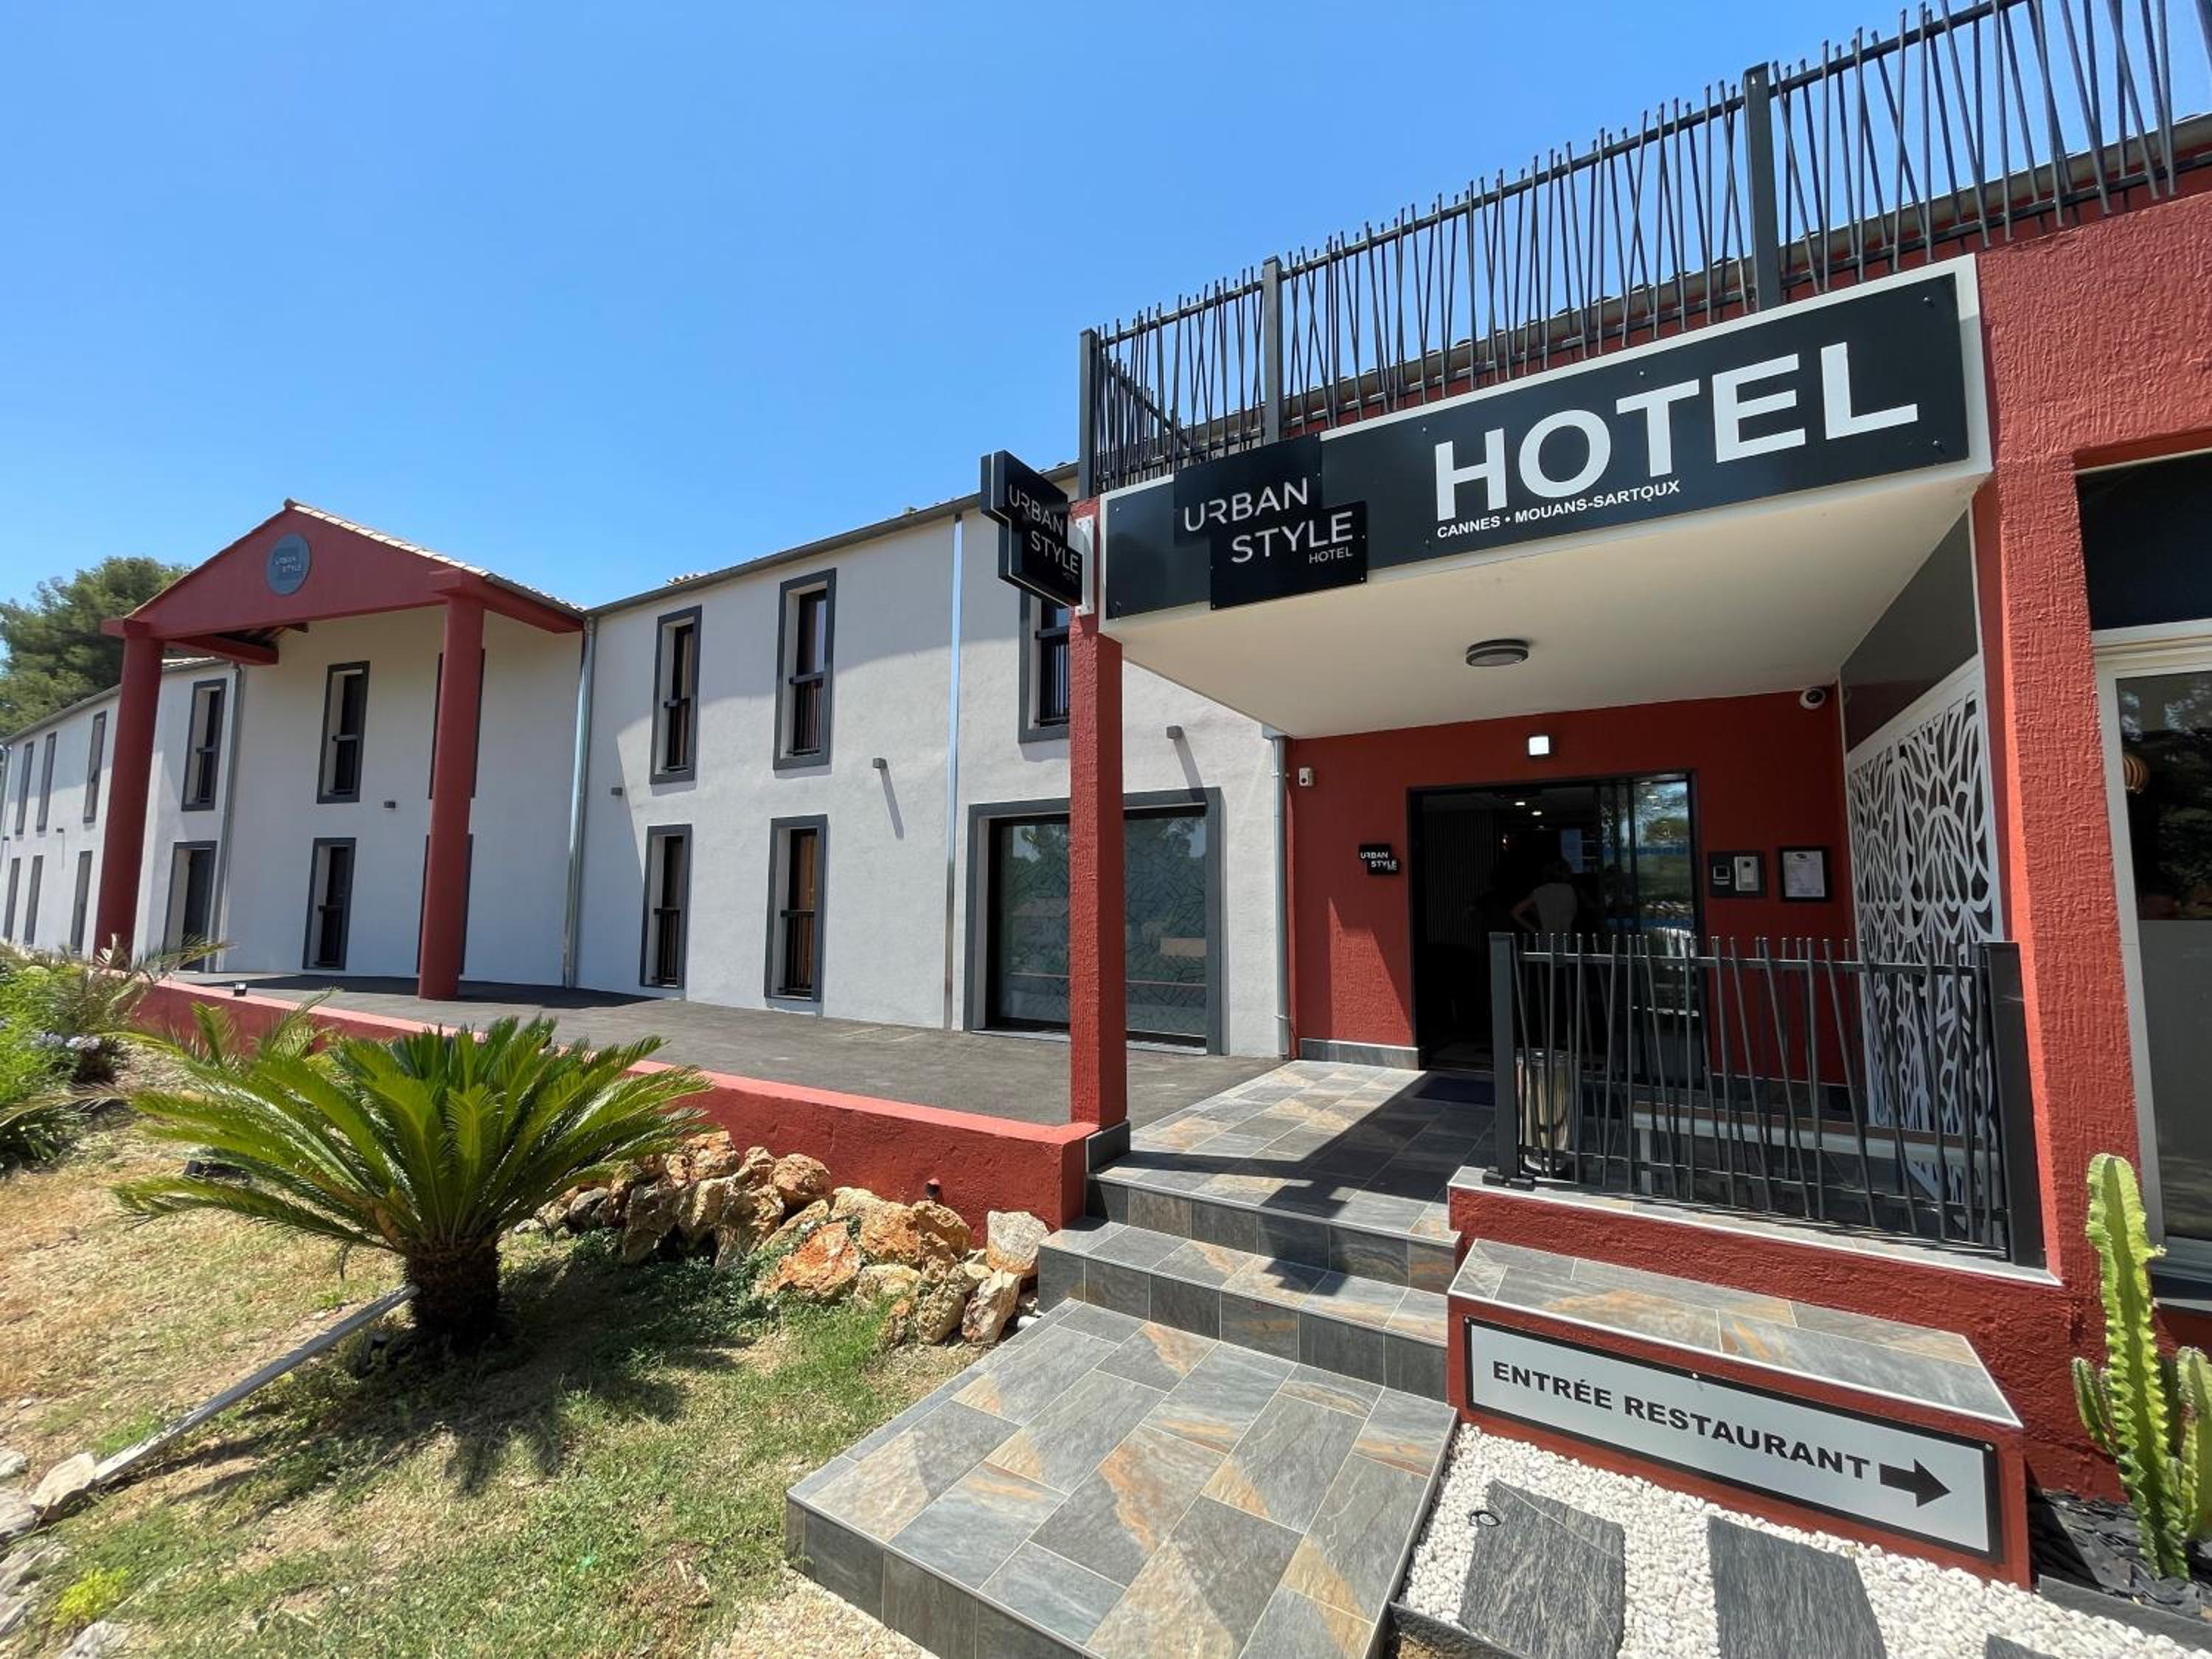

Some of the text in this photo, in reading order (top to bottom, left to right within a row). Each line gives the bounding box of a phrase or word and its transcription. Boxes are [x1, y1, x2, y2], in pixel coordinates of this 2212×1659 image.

[1435, 341, 1919, 521] HOTEL
[1009, 483, 1064, 537] URBAN
[1184, 477, 1308, 532] URBAN
[1437, 479, 1680, 538] CANNES MOUANS-SARTOUX
[1031, 530, 1079, 575] STYLE
[1231, 510, 1354, 563] STYLE
[1309, 546, 1353, 564] HOTEL
[1360, 851, 1389, 859] URBAN
[1371, 859, 1397, 868] STYLE
[1492, 1360, 1871, 1479] ENTRÉE RESTAURANT
